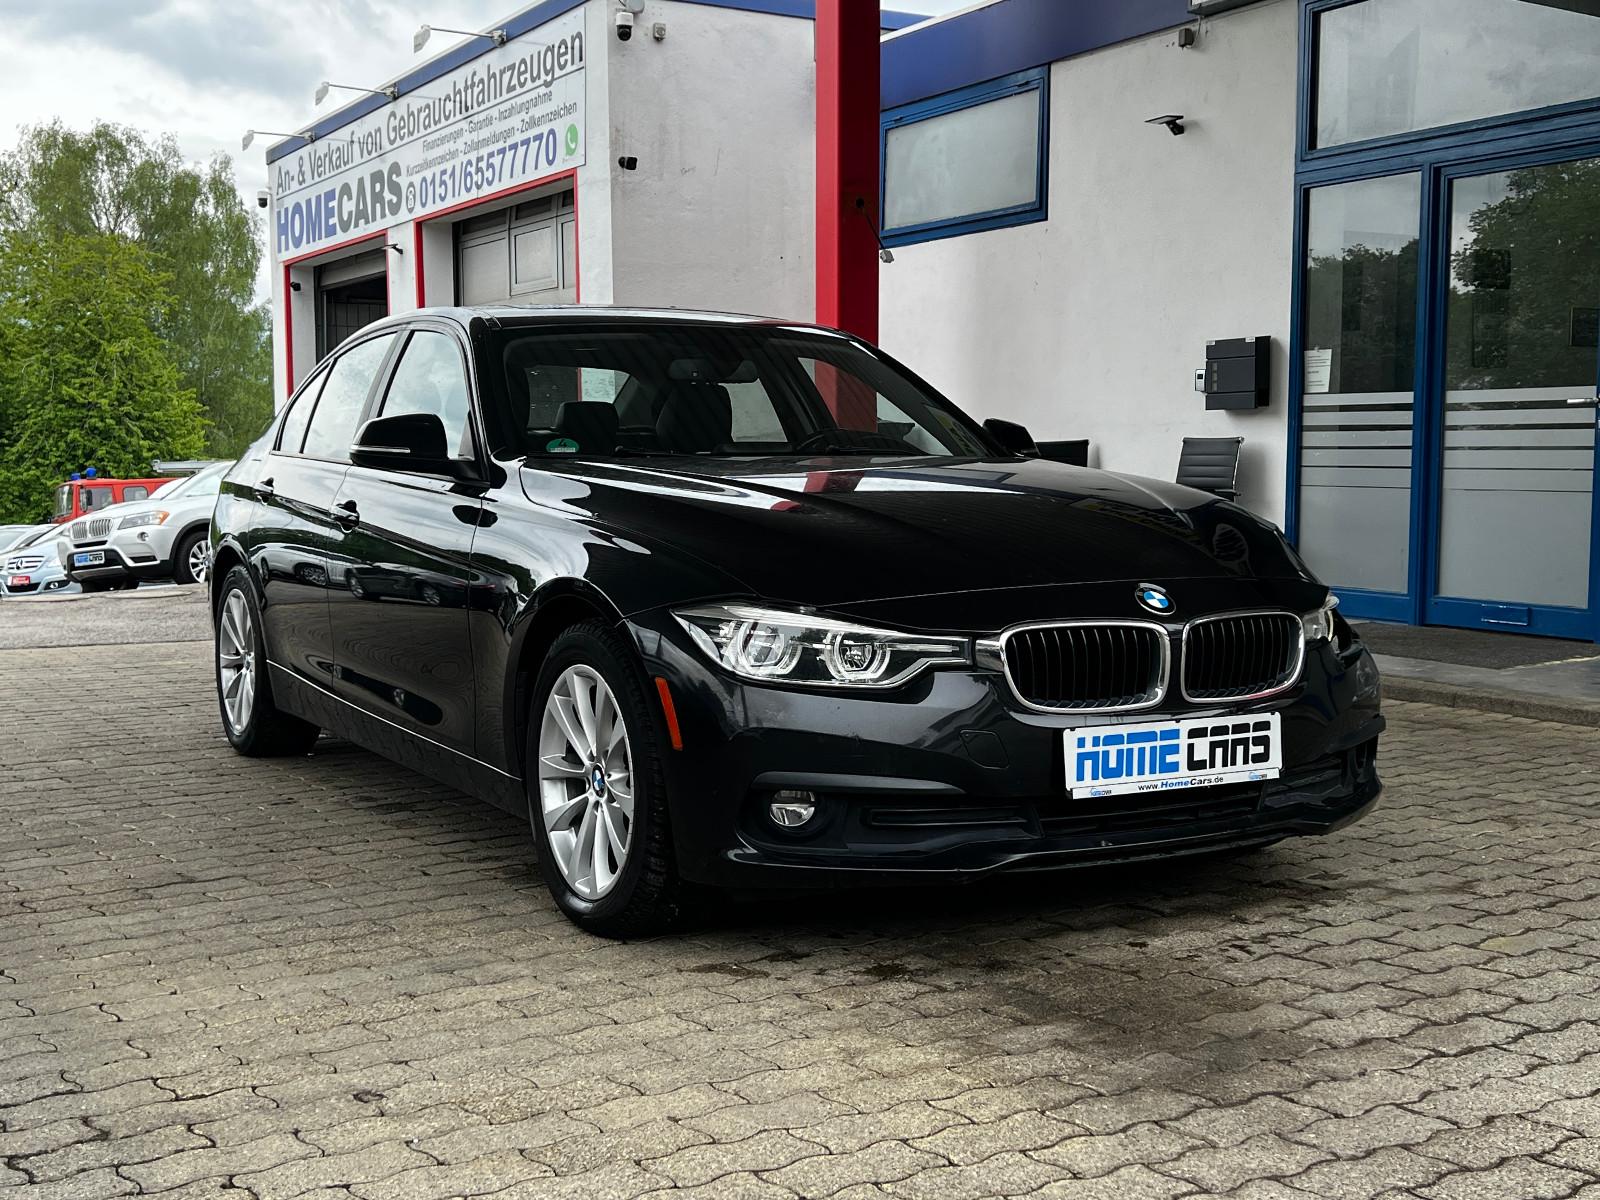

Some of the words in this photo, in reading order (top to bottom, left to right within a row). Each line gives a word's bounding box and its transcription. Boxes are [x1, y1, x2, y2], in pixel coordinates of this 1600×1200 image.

[275, 166, 294, 196] An-
[297, 155, 306, 186] &
[308, 130, 355, 181] Verkauf
[358, 126, 382, 160] von
[386, 30, 584, 147] Gebrauchtfahrzeugen
[422, 127, 464, 153] Finanzierungen
[468, 114, 494, 134] Garantie
[498, 90, 553, 122] Inzahlungnahme
[463, 125, 515, 156] Zollanmeldungen
[520, 101, 577, 133] Zollkennzeichen
[419, 127, 557, 209] 0151/65577770
[276, 160, 403, 255] HOMECARS
[1076, 728, 1181, 782] HOME
[1186, 720, 1272, 772] CARS
[1137, 776, 1224, 792] www.HomeCars.de
